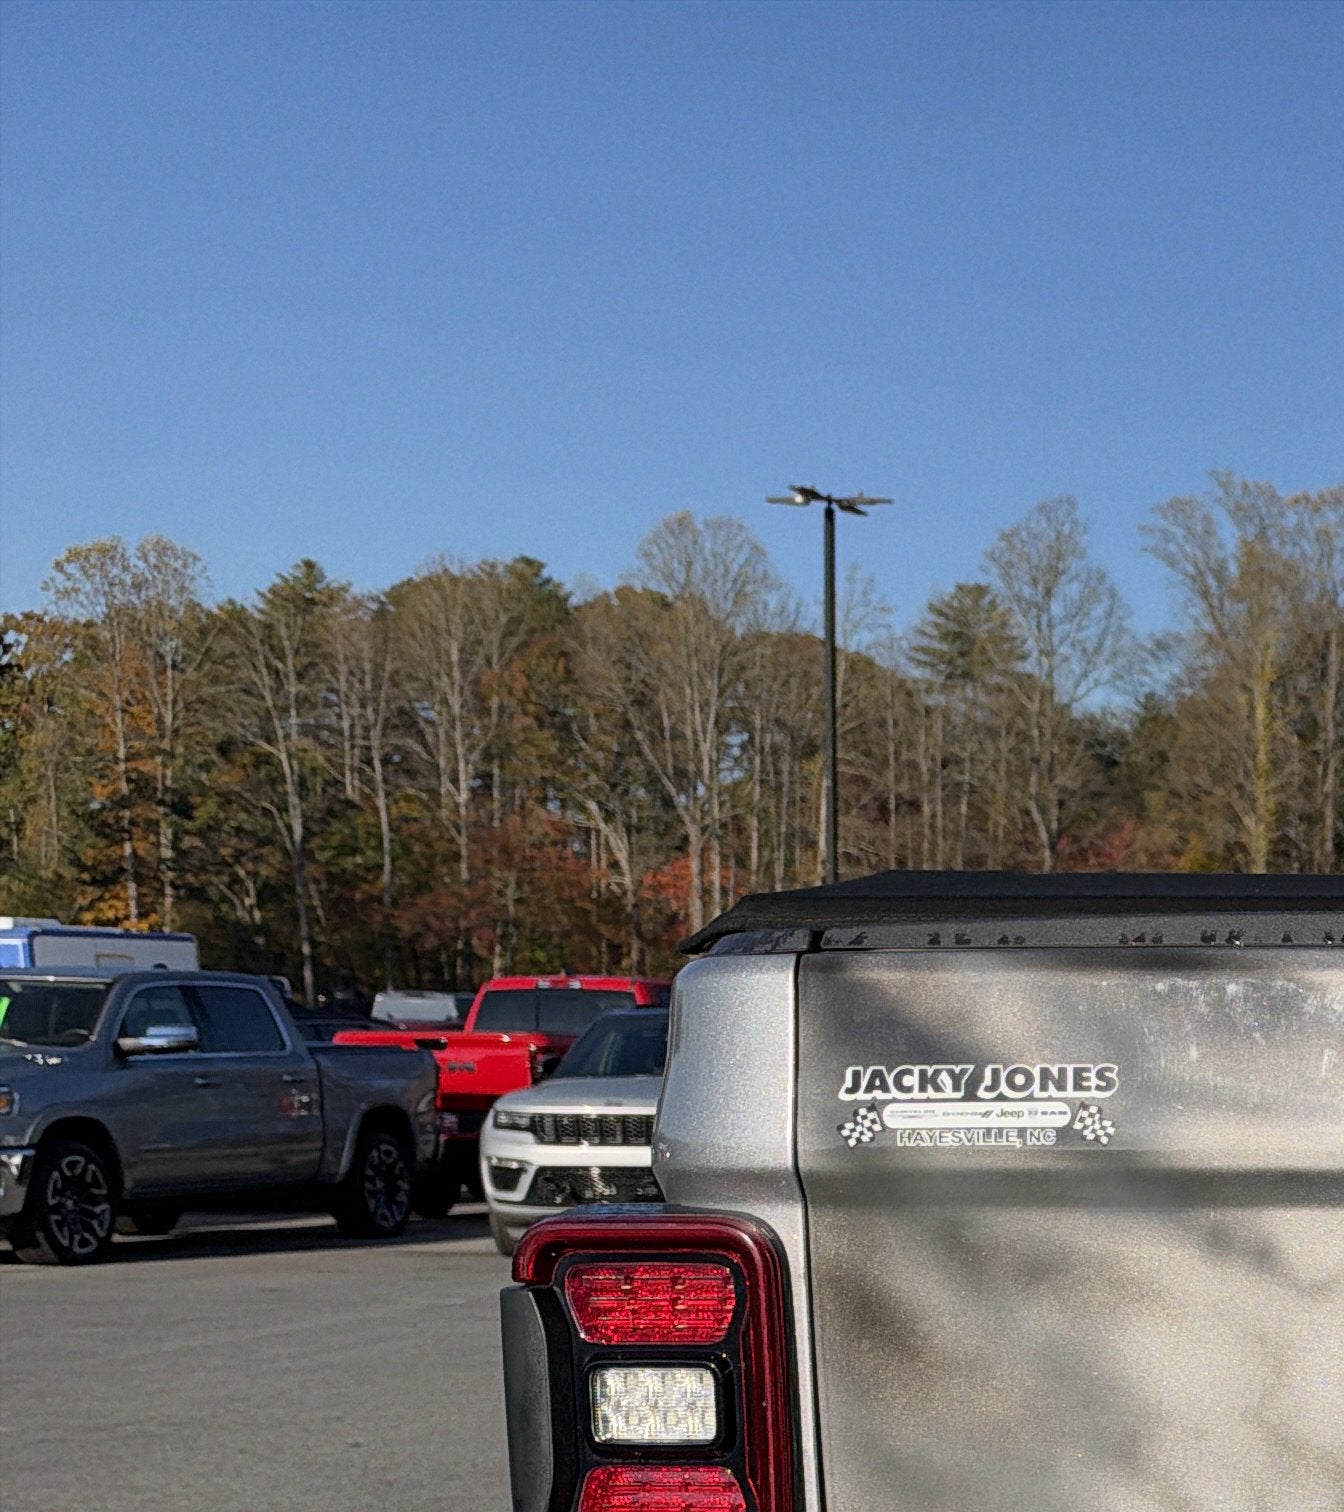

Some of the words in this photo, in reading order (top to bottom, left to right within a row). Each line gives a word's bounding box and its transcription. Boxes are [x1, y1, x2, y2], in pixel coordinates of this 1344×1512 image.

[838, 1064, 975, 1100] JACKY
[977, 1063, 1119, 1099] JONES
[996, 1108, 1024, 1120] Jeep
[1027, 1128, 1057, 1146] NC
